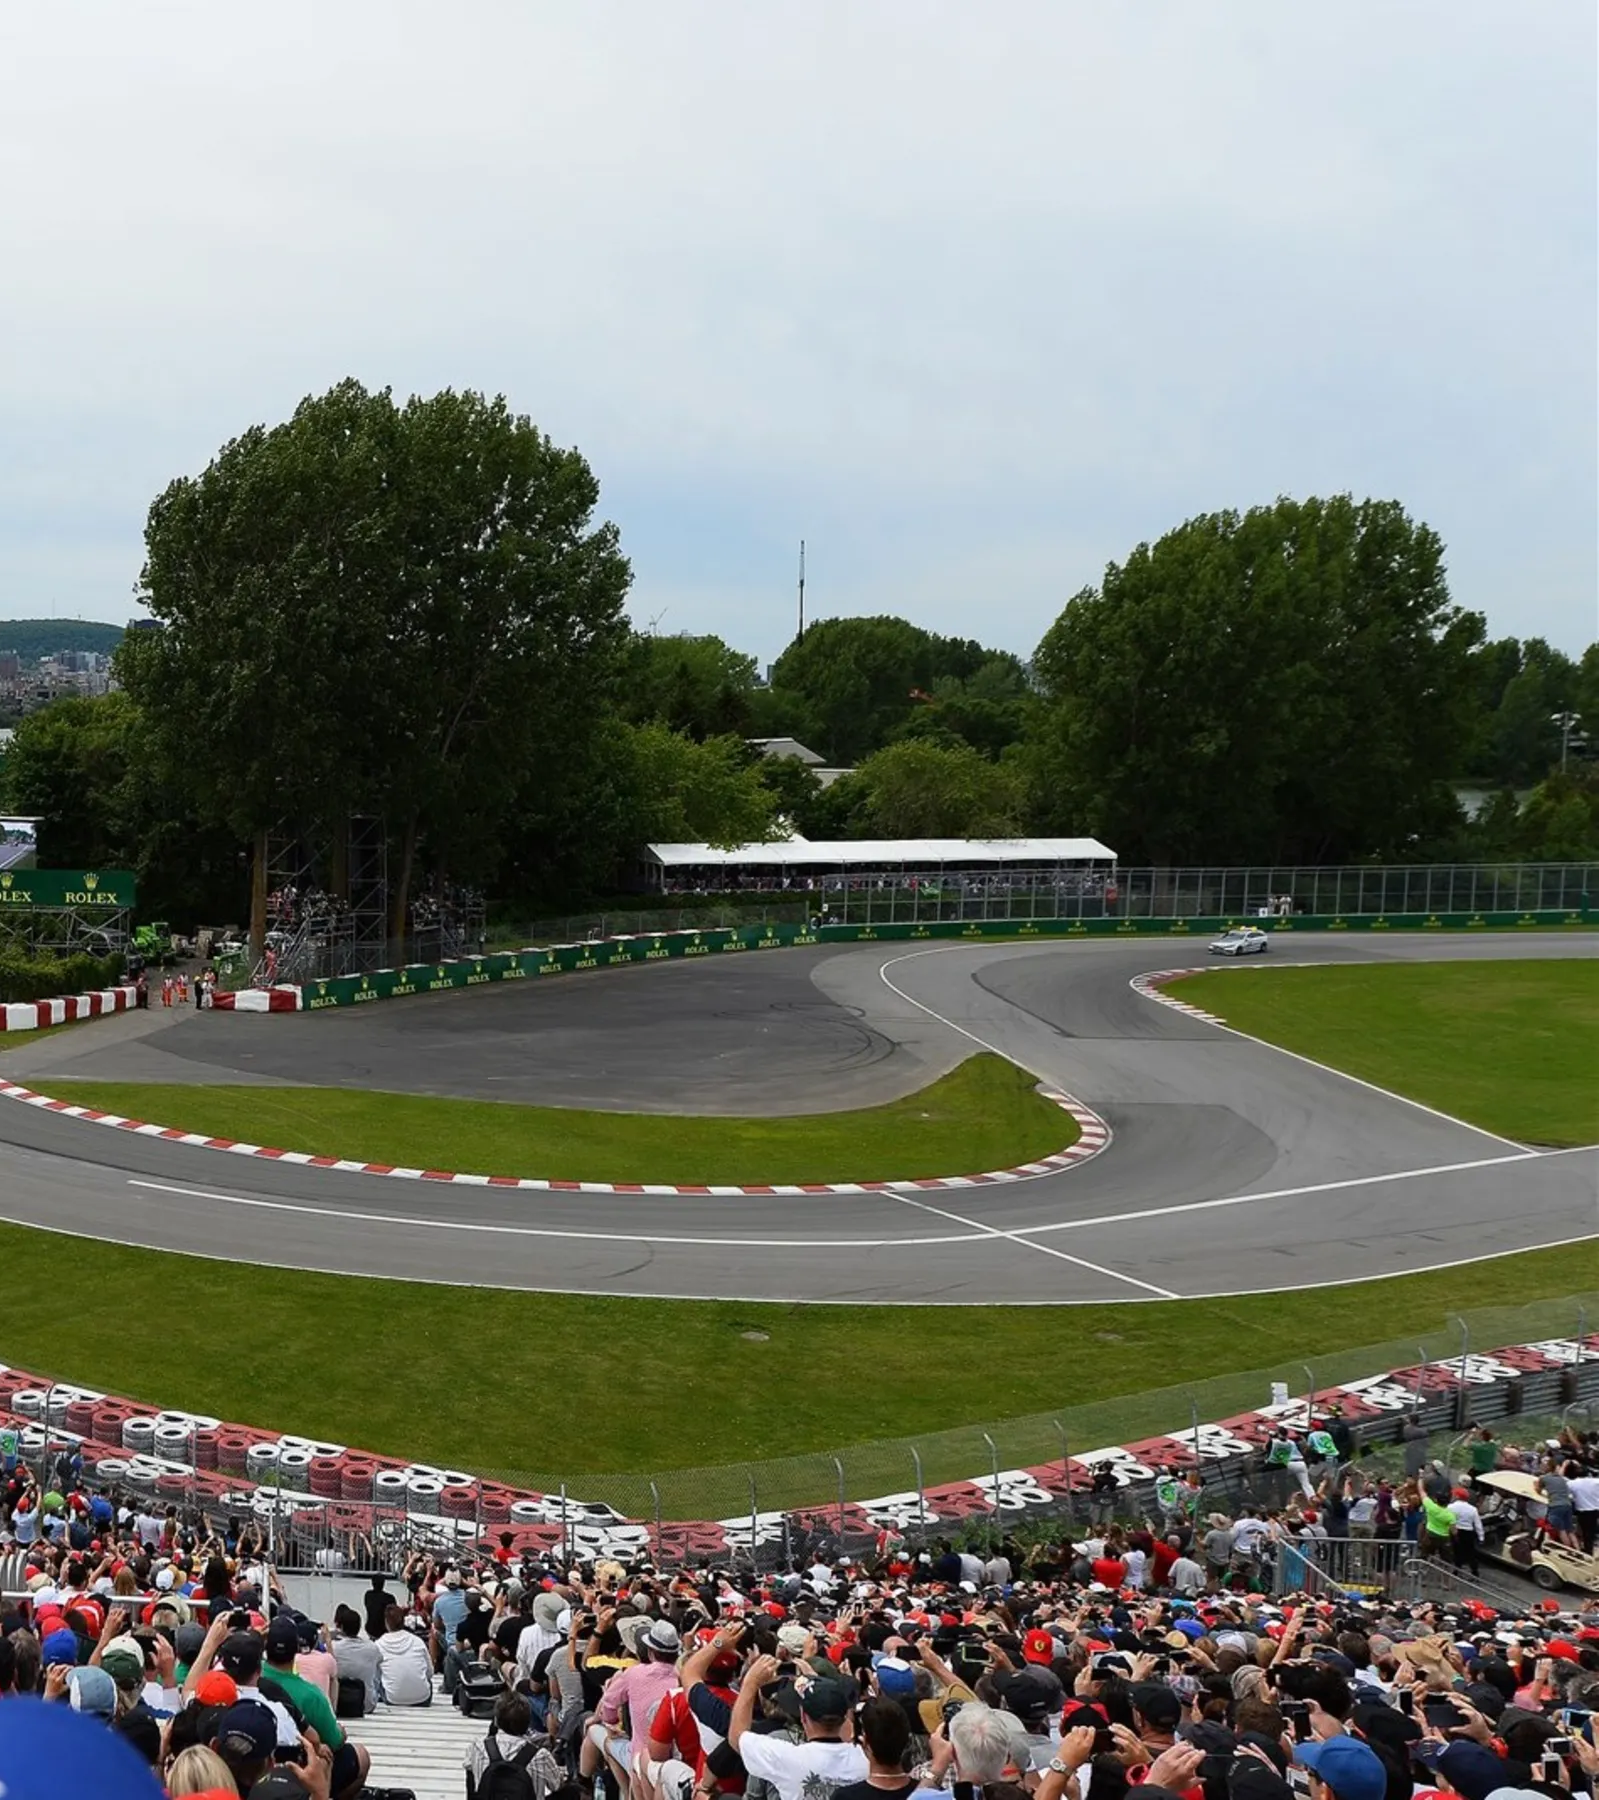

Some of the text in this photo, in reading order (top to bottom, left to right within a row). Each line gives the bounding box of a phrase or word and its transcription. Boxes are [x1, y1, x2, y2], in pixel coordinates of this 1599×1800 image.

[66, 892, 117, 904] ROLEX
[758, 938, 781, 948] ROLEX
[793, 935, 816, 945] ROLEX
[684, 946, 709, 955] ROLEX
[723, 942, 746, 951] ROLEX
[609, 953, 632, 964] ROLEX
[646, 949, 669, 959] ROLEX
[539, 963, 562, 974] ROLEX
[575, 958, 598, 969] ROLEX
[467, 973, 490, 984] ROLEX
[502, 968, 526, 979] ROLEX
[430, 978, 453, 989] ROLEX
[392, 984, 415, 995] ROLEX
[354, 990, 378, 1001] ROLEX
[310, 996, 337, 1009] ROLEX
